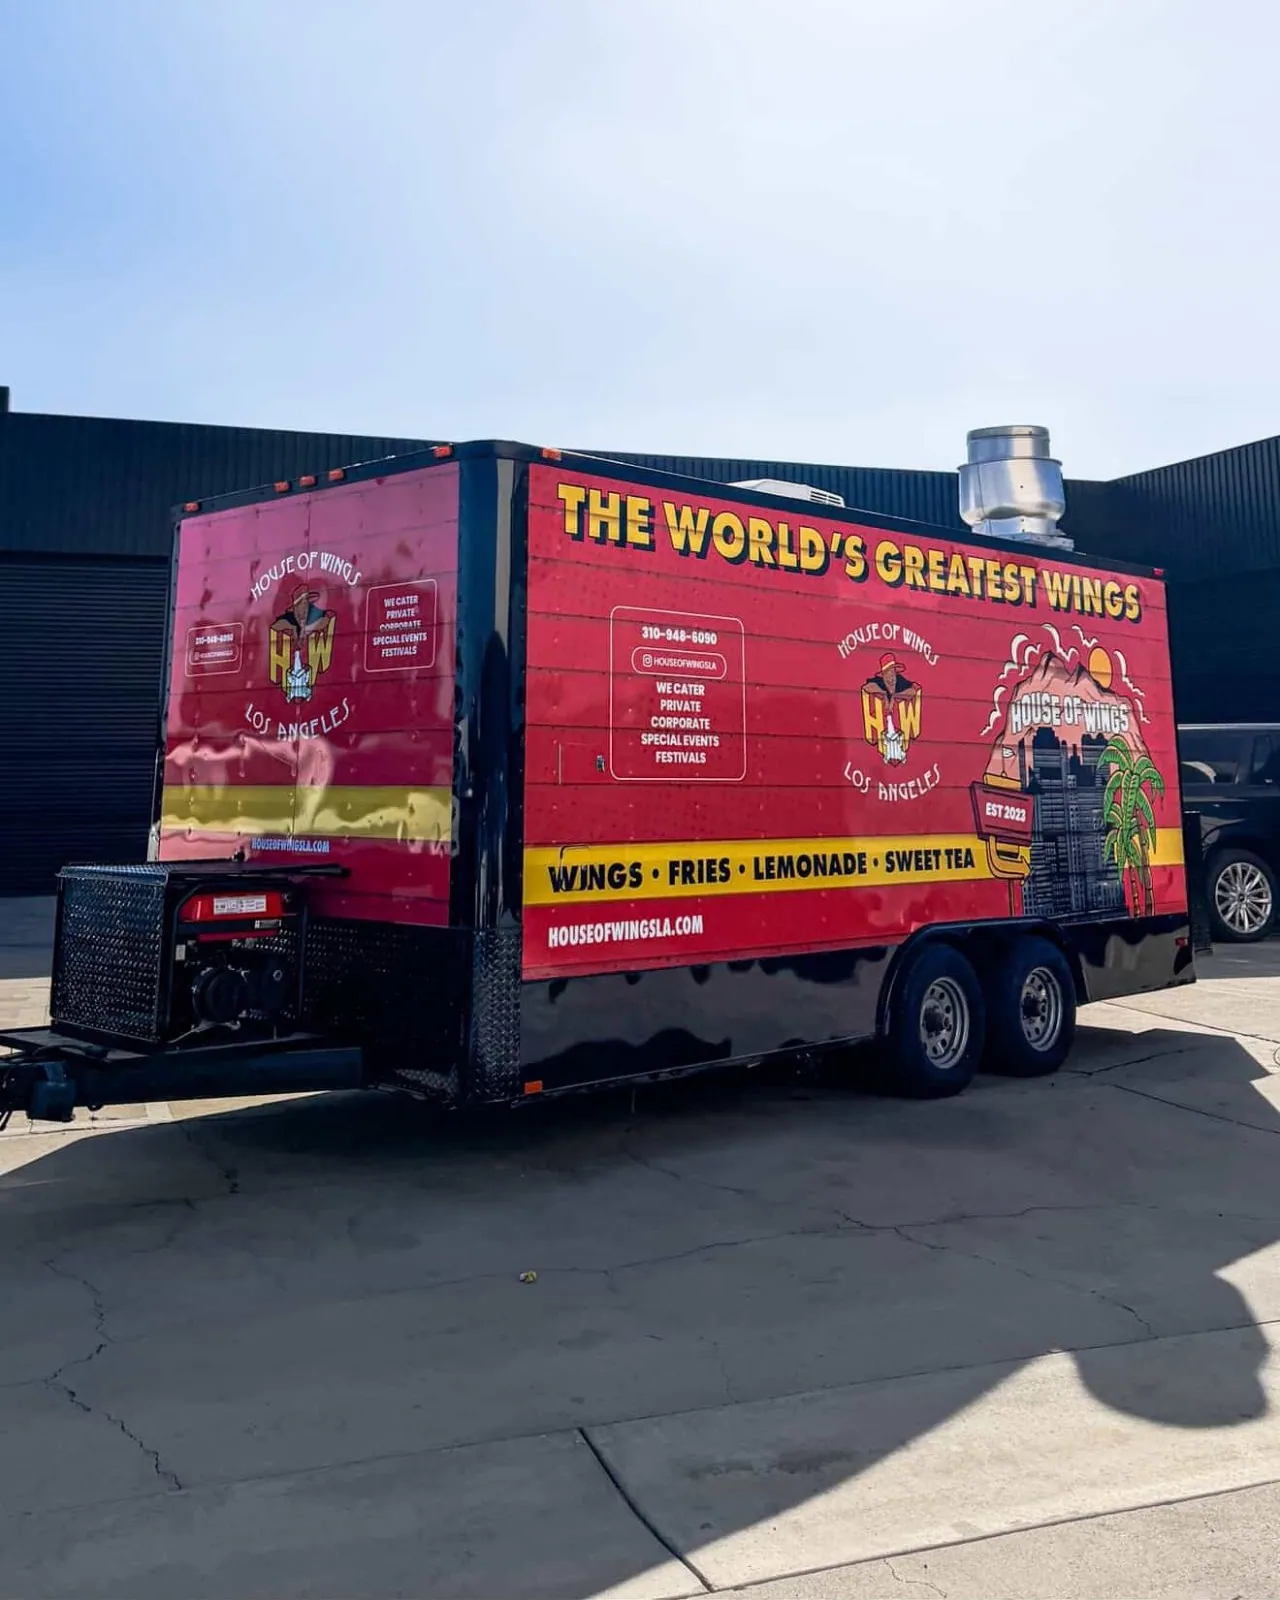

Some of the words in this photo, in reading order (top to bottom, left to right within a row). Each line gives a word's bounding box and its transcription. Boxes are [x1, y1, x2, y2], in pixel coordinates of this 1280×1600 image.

[557, 482, 655, 552] THE
[662, 501, 868, 576] WORLD'S
[875, 540, 1038, 608] GREATEST
[1042, 568, 1142, 624] WINGS
[250, 555, 296, 602] HOUSE
[297, 551, 318, 570] OF
[319, 551, 363, 587] WINGS
[384, 598, 395, 607] WE
[396, 595, 418, 605] CATER
[386, 608, 415, 619] PRIVATE
[400, 633, 427, 643] EVENTS
[642, 627, 717, 644] 310-948-6090
[382, 646, 417, 657] FESTIVALS
[837, 622, 880, 659] HOUSE
[881, 623, 900, 641] OF
[902, 627, 940, 667] WINGS
[656, 681, 673, 695] WE
[673, 682, 705, 697] CATER
[660, 699, 702, 713] PRIVATE
[1011, 692, 1061, 734] HOUSE
[1064, 695, 1081, 726] OF
[1082, 702, 1130, 734] WINGS
[244, 703, 272, 735] LOS
[276, 697, 350, 743] ANGELES
[650, 716, 711, 730] CORPORATE
[641, 733, 682, 746] SPECIAL
[682, 735, 720, 747] EVENTS
[655, 751, 707, 764] FESTIVALS
[844, 761, 872, 794] LOS
[878, 763, 942, 802] ANGELES
[985, 802, 1003, 818] EST
[548, 862, 643, 893] WINGS
[668, 857, 731, 886] FRIES
[753, 852, 868, 881] LEMONADE
[885, 849, 942, 873] SWEET
[944, 848, 976, 869] TEA
[548, 914, 704, 948] HOUSEOFWINGSLA.COM
